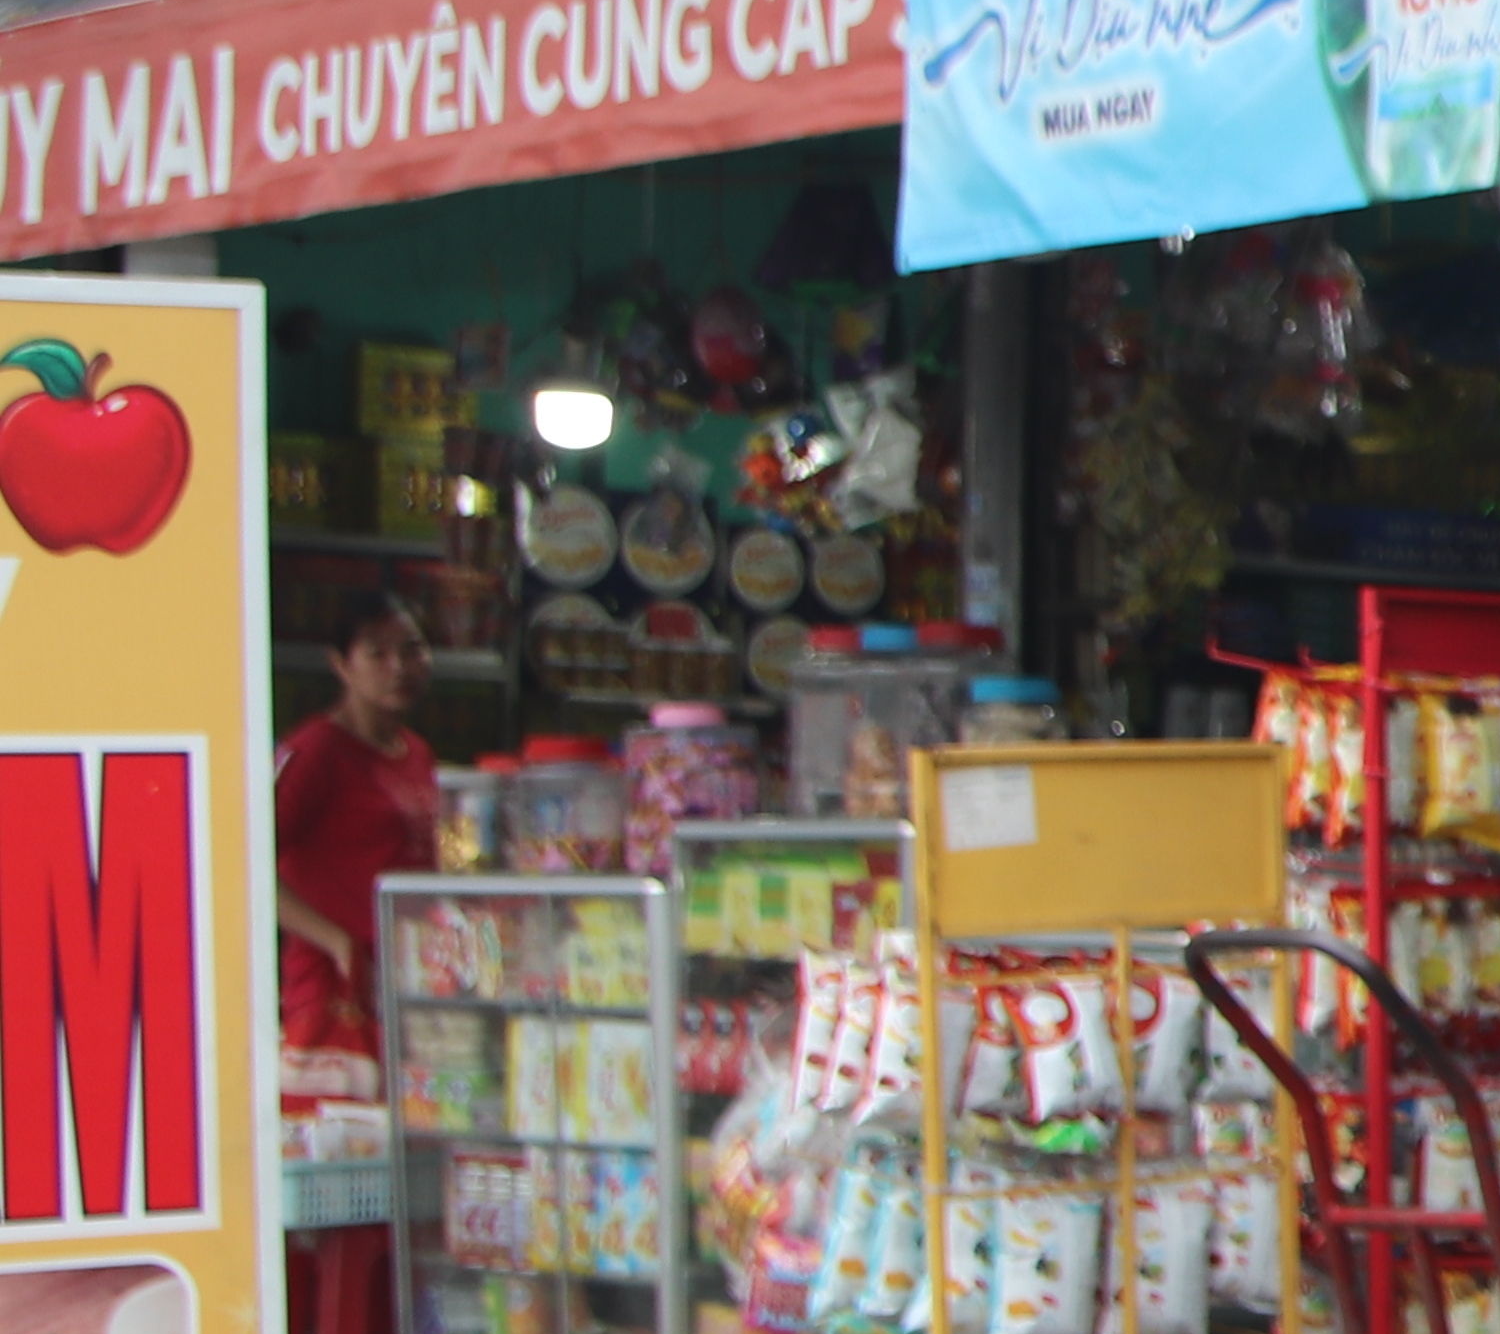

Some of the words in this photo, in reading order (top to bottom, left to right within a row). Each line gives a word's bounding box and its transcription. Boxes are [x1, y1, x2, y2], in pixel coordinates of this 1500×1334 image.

[79, 46, 236, 216] MAI
[1043, 103, 1091, 140] MUA
[1096, 87, 1155, 131] NGAY
